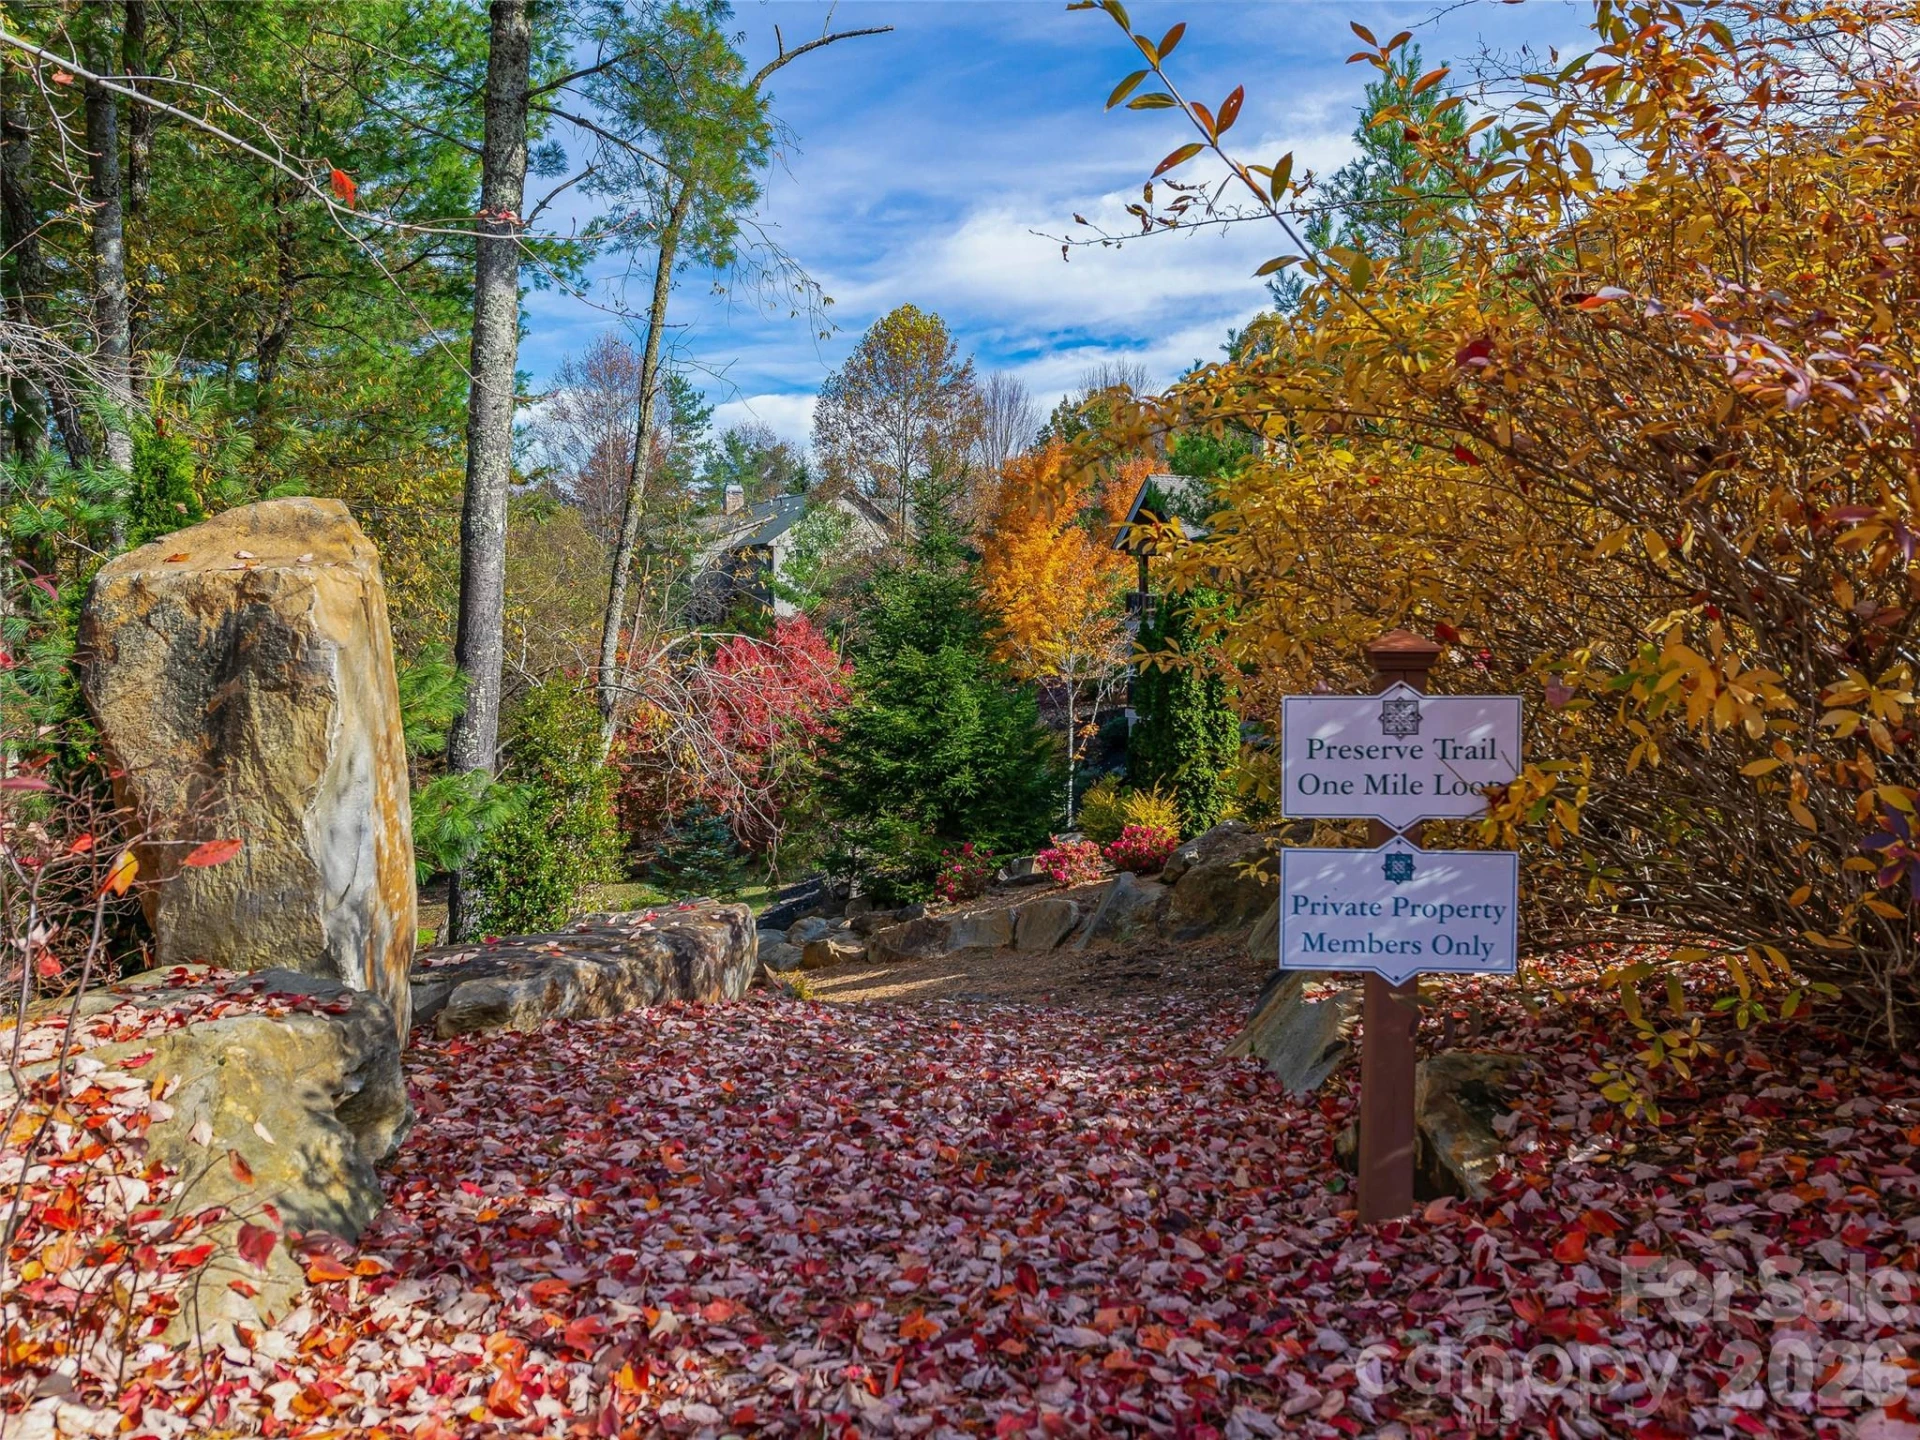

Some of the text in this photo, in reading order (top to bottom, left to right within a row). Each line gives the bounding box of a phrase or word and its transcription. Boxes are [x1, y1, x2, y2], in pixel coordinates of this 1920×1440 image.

[1306, 737, 1498, 761] Preserve Trail
[1297, 772, 1354, 796] One
[1364, 773, 1424, 796] Mile
[1291, 895, 1507, 925] Private Property
[1302, 932, 1495, 962] Members Only
